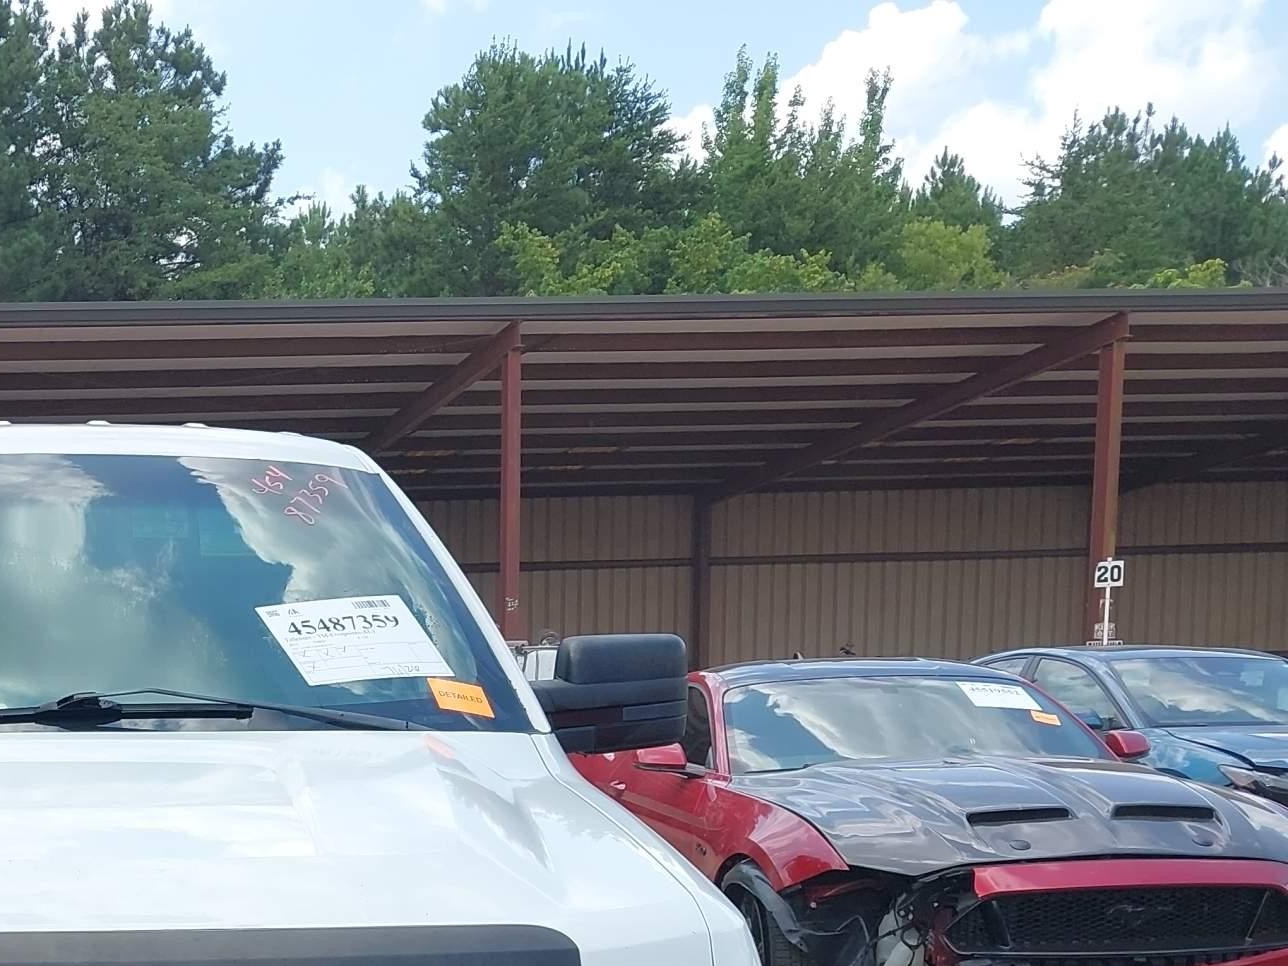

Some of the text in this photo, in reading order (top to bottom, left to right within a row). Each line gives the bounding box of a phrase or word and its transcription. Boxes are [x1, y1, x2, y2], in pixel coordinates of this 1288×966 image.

[251, 465, 293, 495] 454
[284, 473, 349, 525] 87359
[1097, 564, 1122, 583] 20
[288, 614, 399, 635] 45487359
[438, 690, 483, 704] DETAILED
